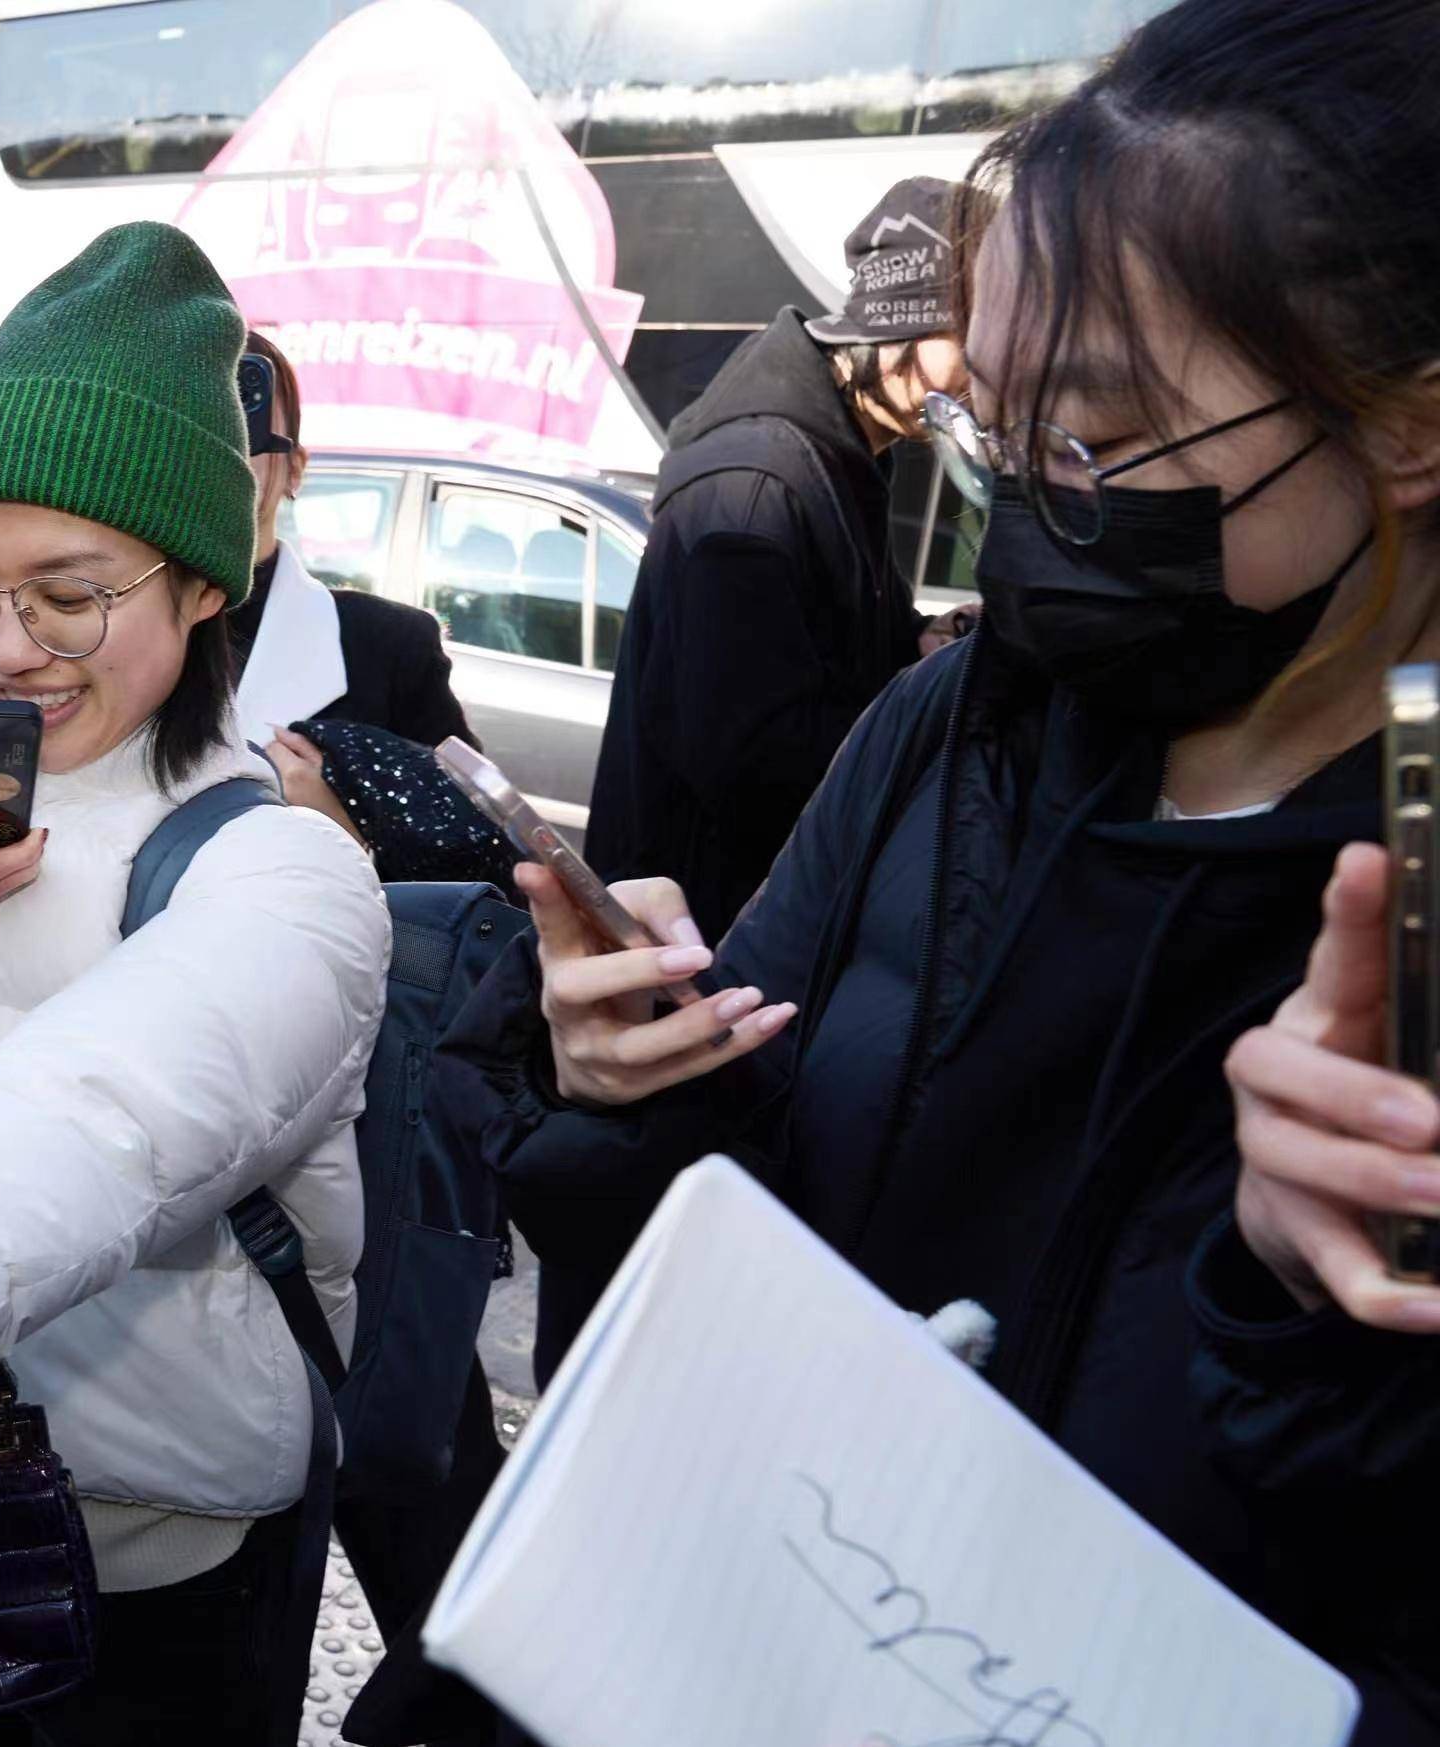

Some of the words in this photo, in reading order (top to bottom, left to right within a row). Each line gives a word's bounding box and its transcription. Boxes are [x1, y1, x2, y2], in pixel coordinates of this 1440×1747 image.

[862, 246, 928, 280] SNOW
[866, 261, 936, 293] KOREA
[864, 299, 937, 315] KOREA
[256, 308, 595, 403] enreizen.nl
